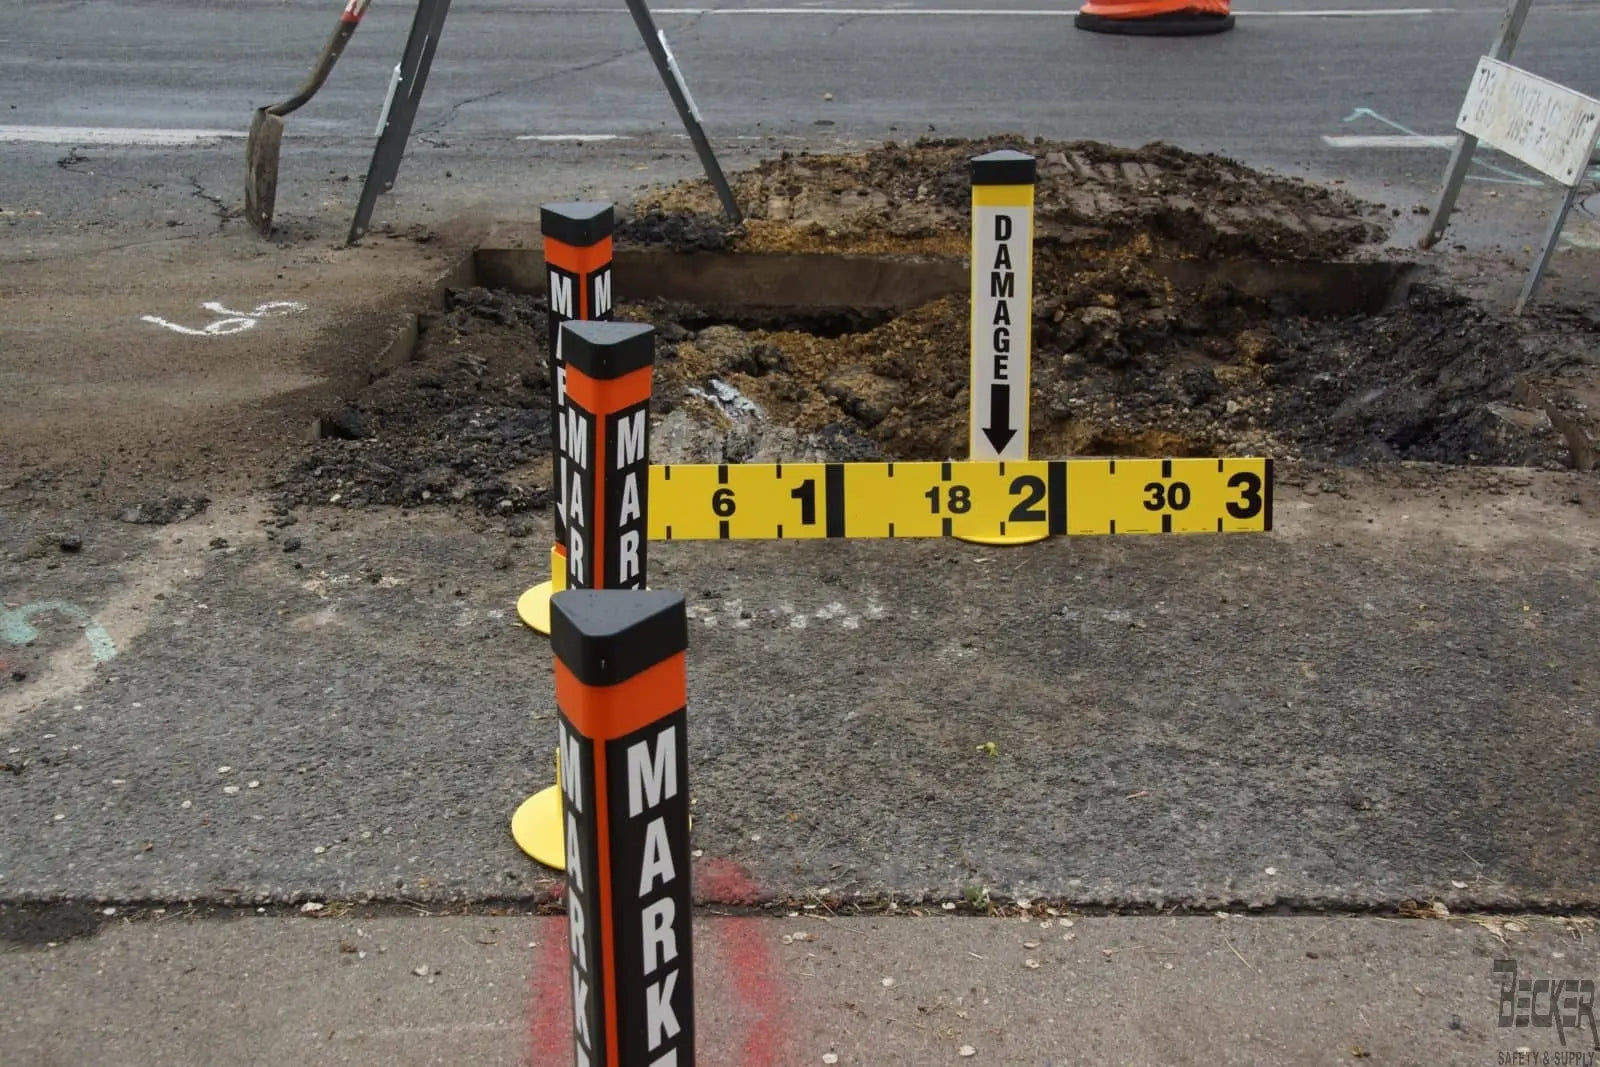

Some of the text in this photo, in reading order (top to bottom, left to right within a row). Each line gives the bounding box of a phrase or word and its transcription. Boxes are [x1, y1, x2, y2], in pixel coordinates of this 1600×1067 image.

[990, 215, 1014, 380] DAMAGE
[568, 407, 588, 590] MAR
[616, 408, 646, 590] MAR
[712, 472, 1262, 525] 6 1 18 2 30 3
[559, 719, 591, 1051] MARK
[627, 725, 682, 1052] MARK
